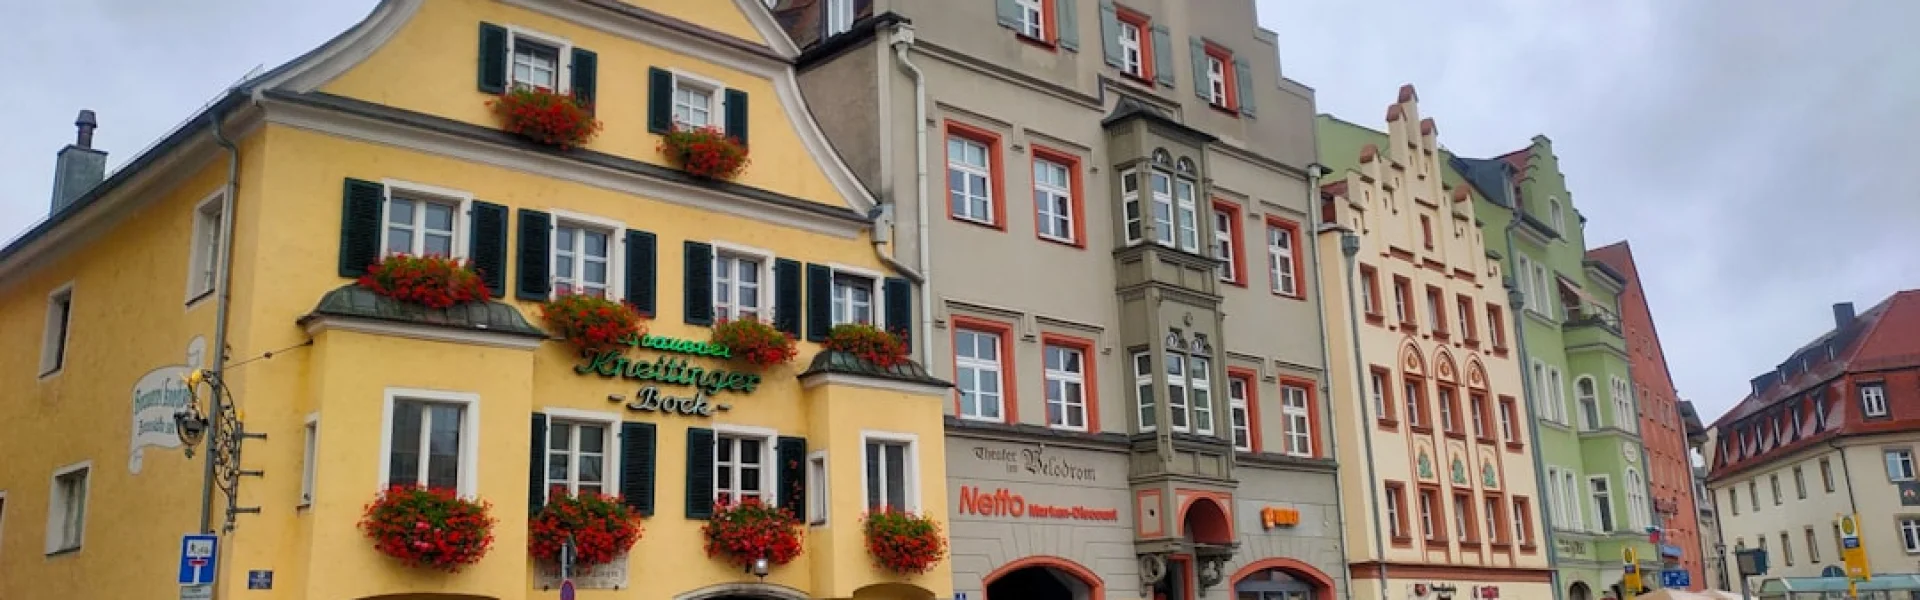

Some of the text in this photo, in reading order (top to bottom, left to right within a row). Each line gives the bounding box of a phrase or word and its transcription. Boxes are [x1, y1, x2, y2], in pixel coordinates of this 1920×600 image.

[574, 351, 761, 394] Kneitinger
[626, 384, 713, 416] Bock
[973, 446, 1017, 462] Theater
[1023, 445, 1096, 481] Velodrom
[959, 484, 1025, 518] Netto
